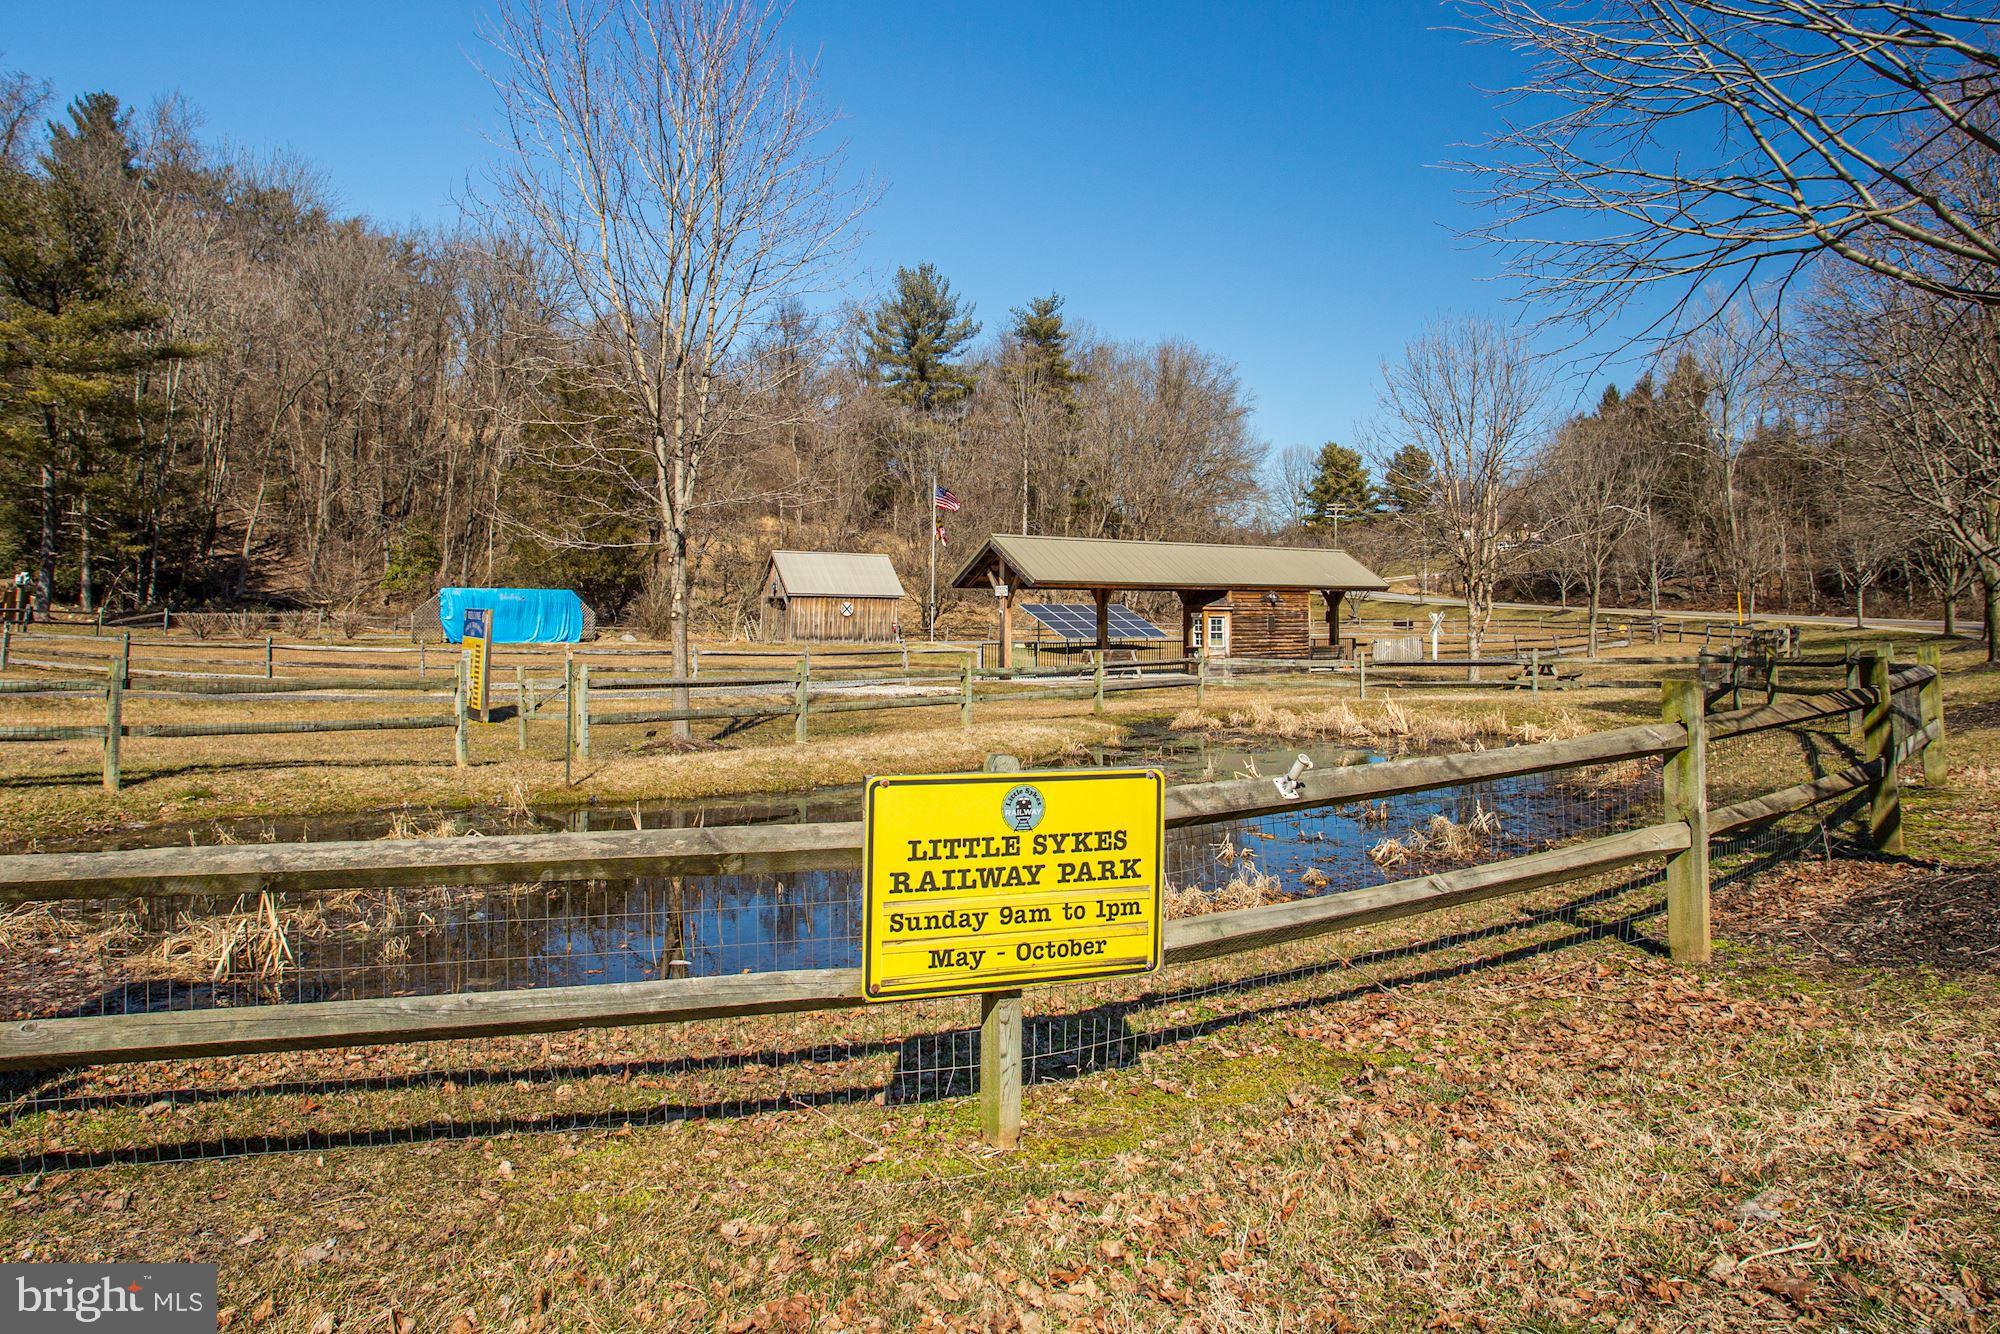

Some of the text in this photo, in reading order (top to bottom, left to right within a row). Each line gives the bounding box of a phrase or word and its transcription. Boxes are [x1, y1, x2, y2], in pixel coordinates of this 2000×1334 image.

[1005, 788, 1042, 807] Little Sykes
[1005, 809, 1042, 817] RAILWAY
[907, 829, 1128, 862] LITTLE SYKES
[888, 858, 1142, 894] RAILWAY PARK
[889, 900, 1142, 933] Sunday 9am to 1pm
[928, 948, 986, 970] May
[1016, 938, 1107, 961] October
